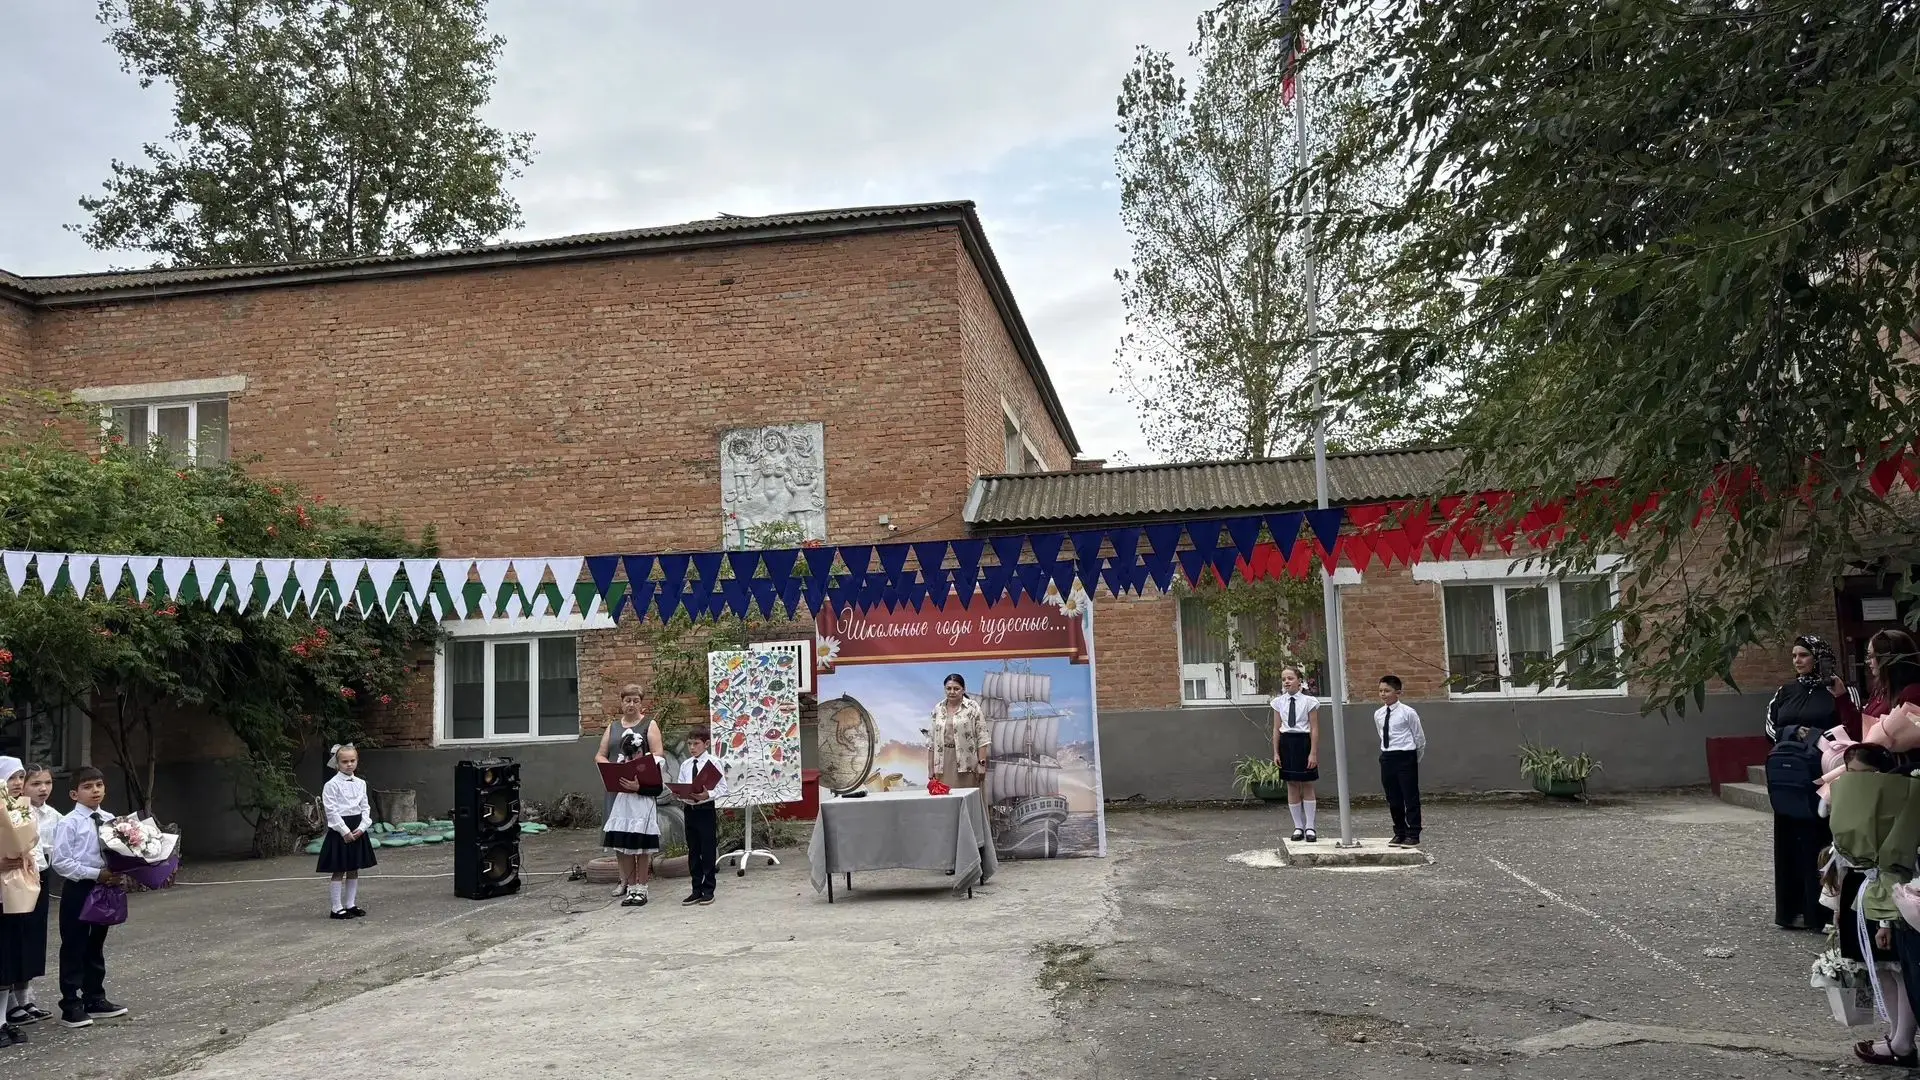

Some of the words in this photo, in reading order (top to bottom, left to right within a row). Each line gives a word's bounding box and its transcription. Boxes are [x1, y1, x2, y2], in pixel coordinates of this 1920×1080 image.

[836, 606, 929, 641] Школьные
[935, 619, 973, 646] годы
[979, 615, 1067, 645] чудесные...
